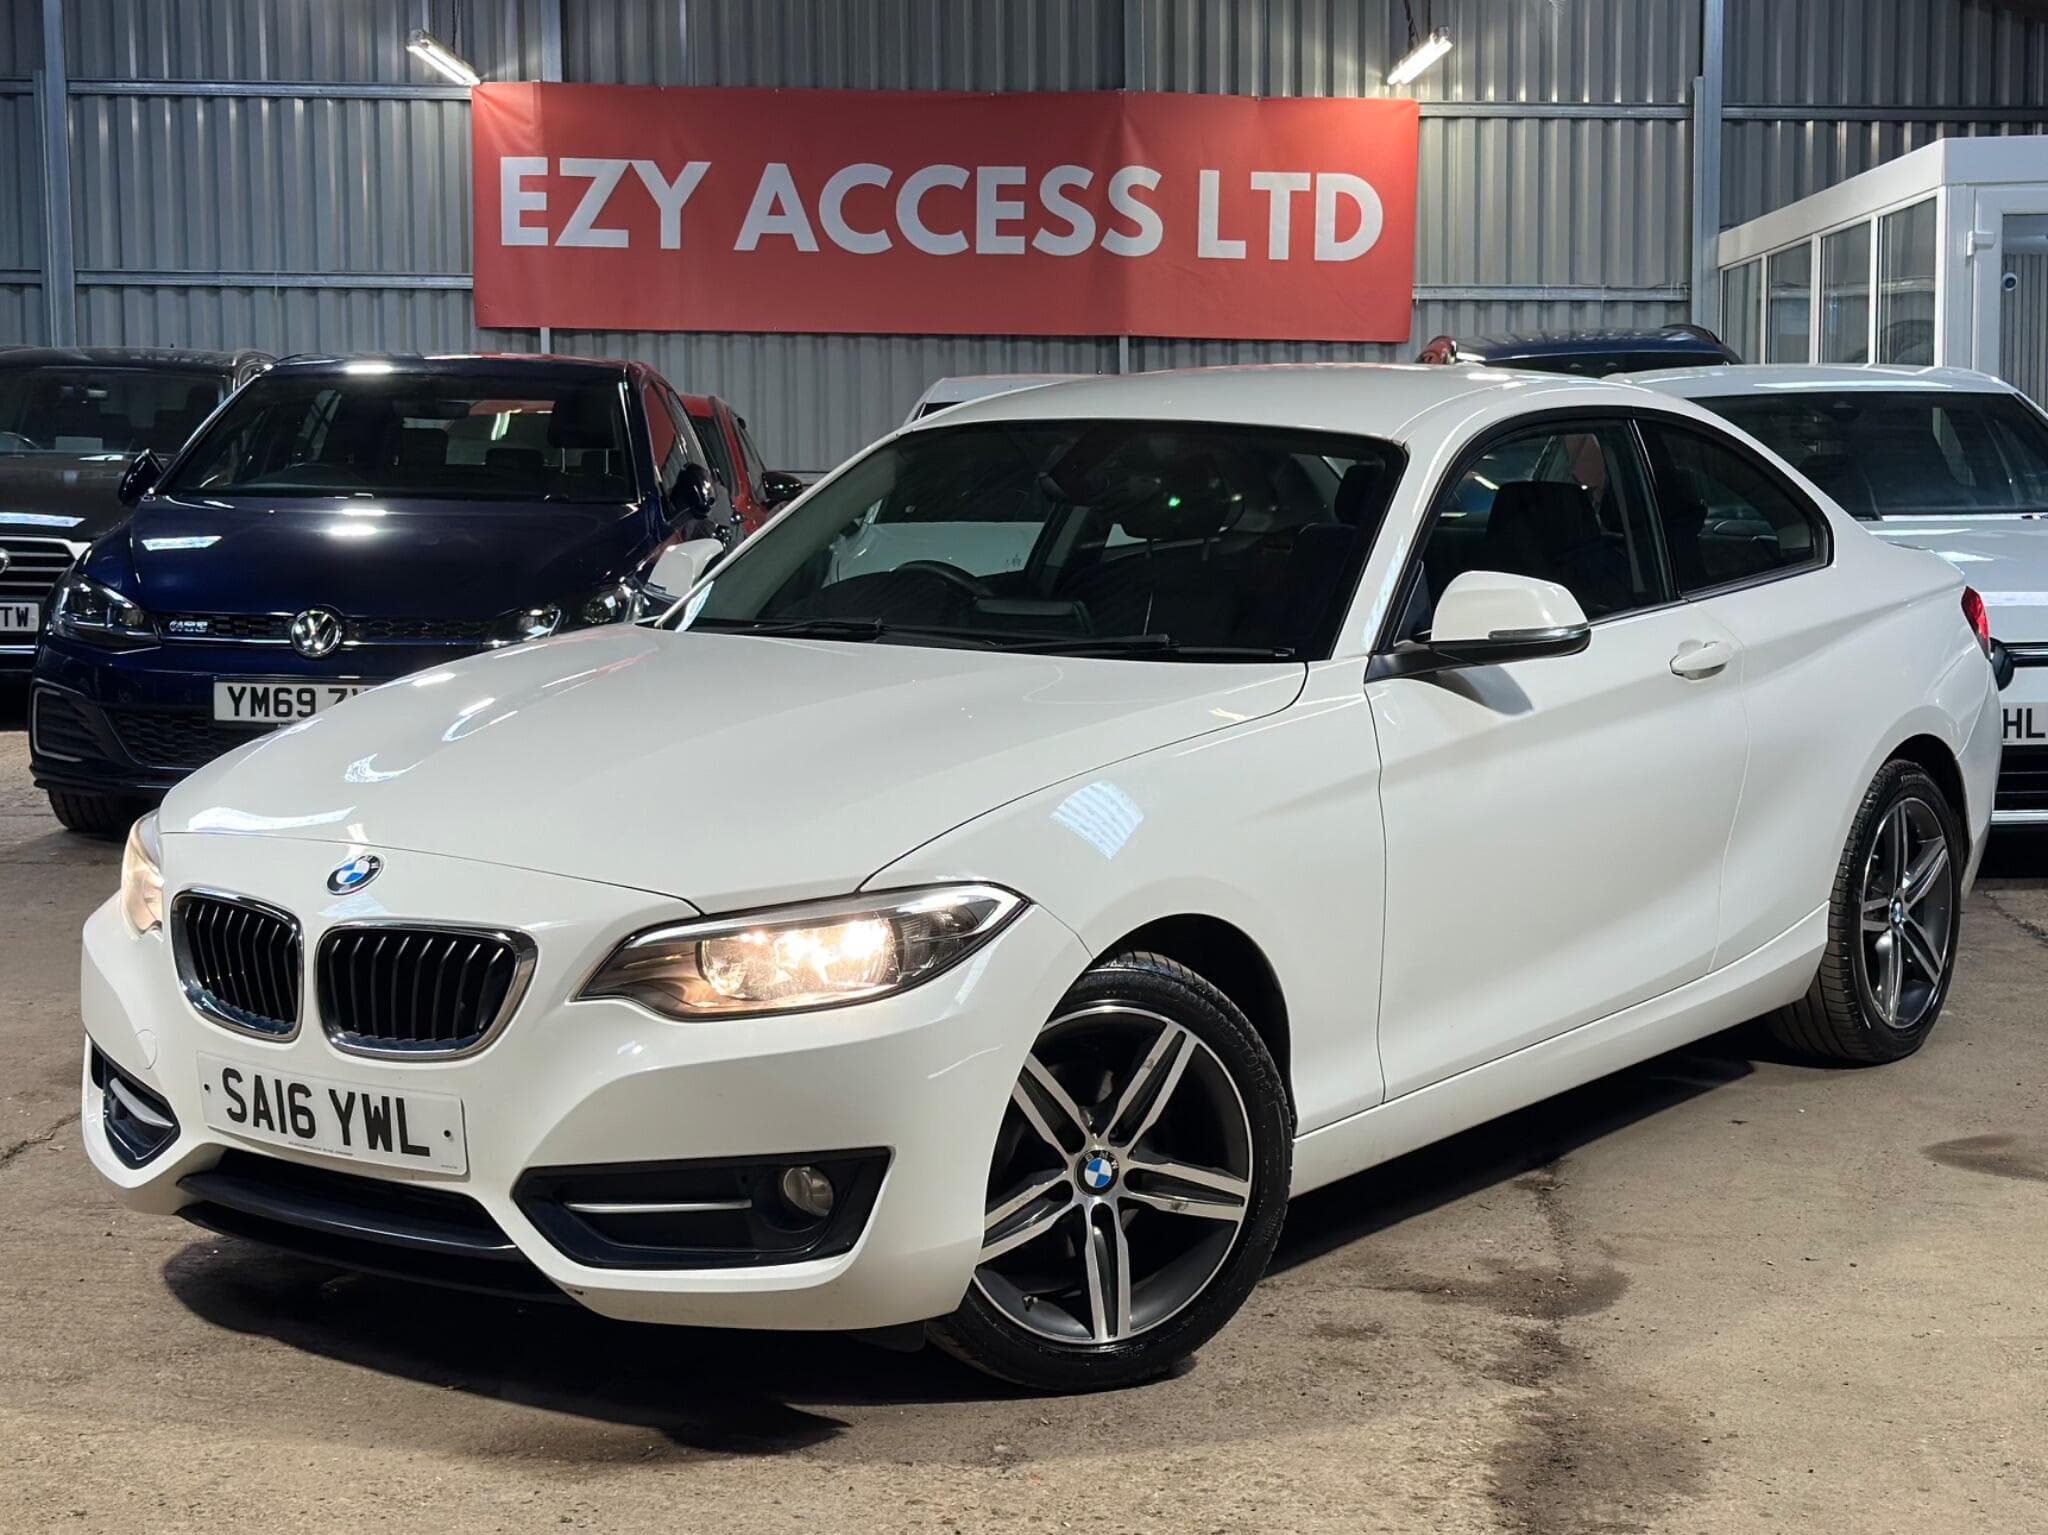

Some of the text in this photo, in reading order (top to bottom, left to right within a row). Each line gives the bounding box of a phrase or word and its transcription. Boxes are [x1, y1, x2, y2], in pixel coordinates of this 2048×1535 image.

[501, 156, 1384, 262] EZY ACCESS LTD
[0, 606, 30, 627] TW
[227, 685, 317, 718] YM69
[2002, 708, 2046, 739] HL
[222, 1067, 431, 1157] SA16 YWL
